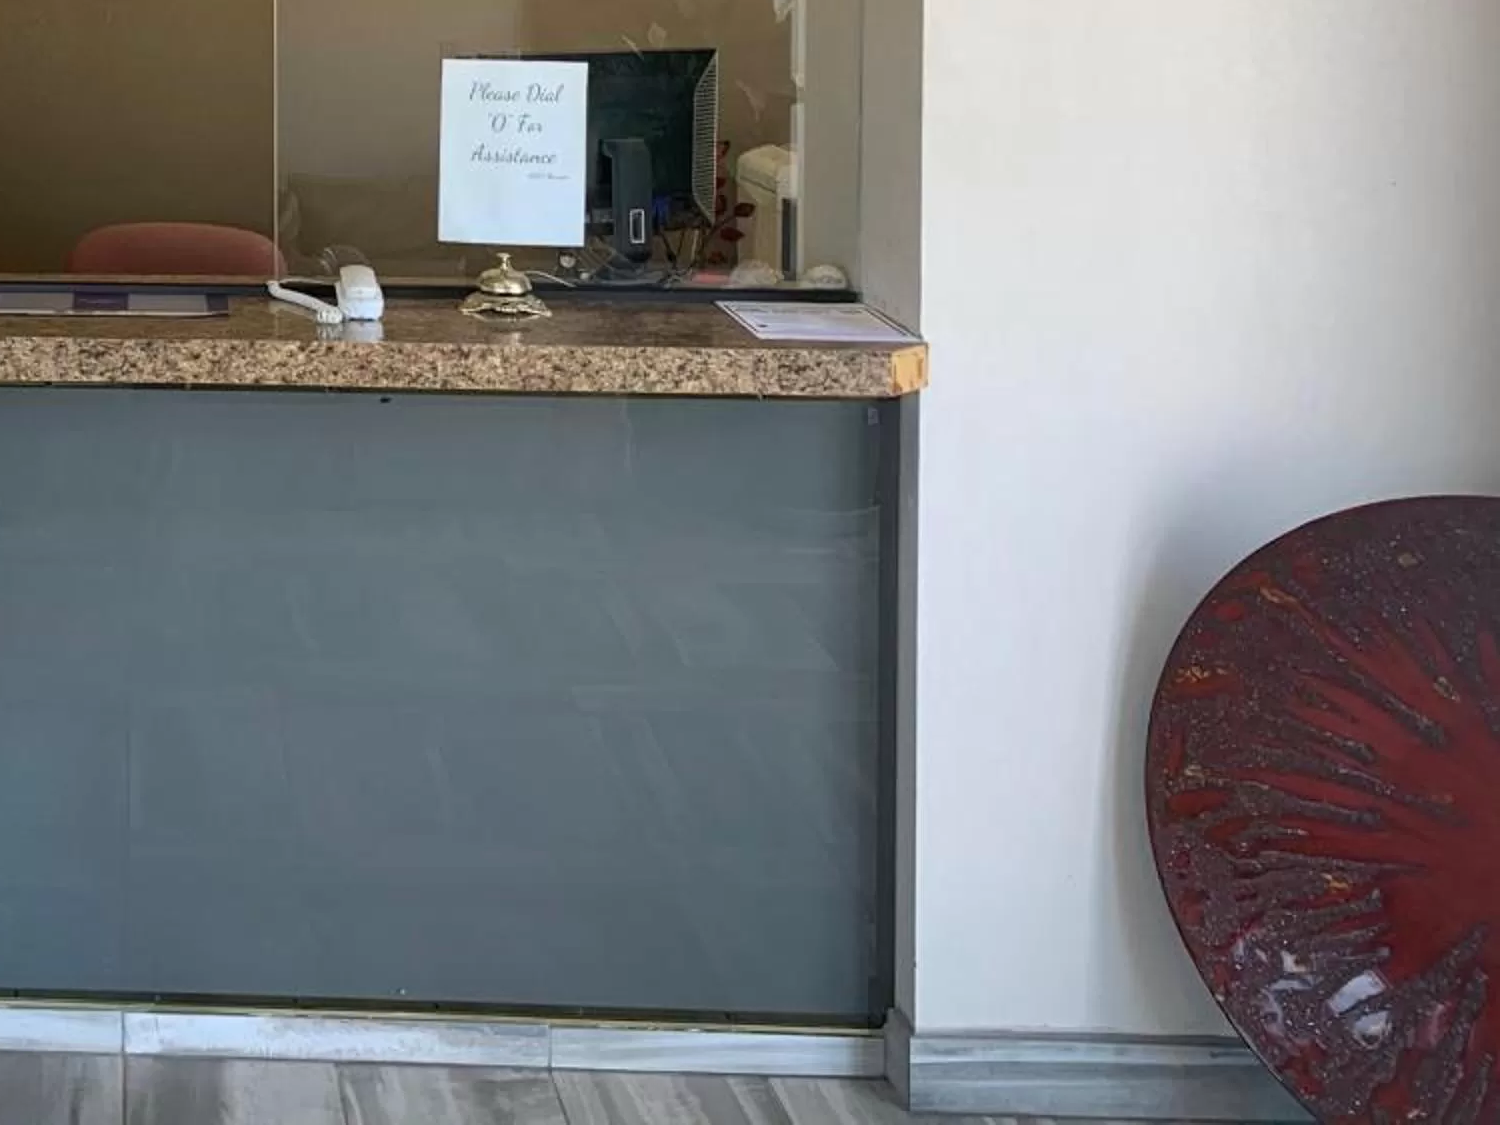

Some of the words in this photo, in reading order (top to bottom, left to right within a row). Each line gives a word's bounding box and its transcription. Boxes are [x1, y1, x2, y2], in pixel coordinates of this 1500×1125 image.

[469, 80, 520, 102] Please
[525, 82, 564, 104] Dial
[517, 113, 543, 133] For
[470, 142, 557, 165] Assistance
